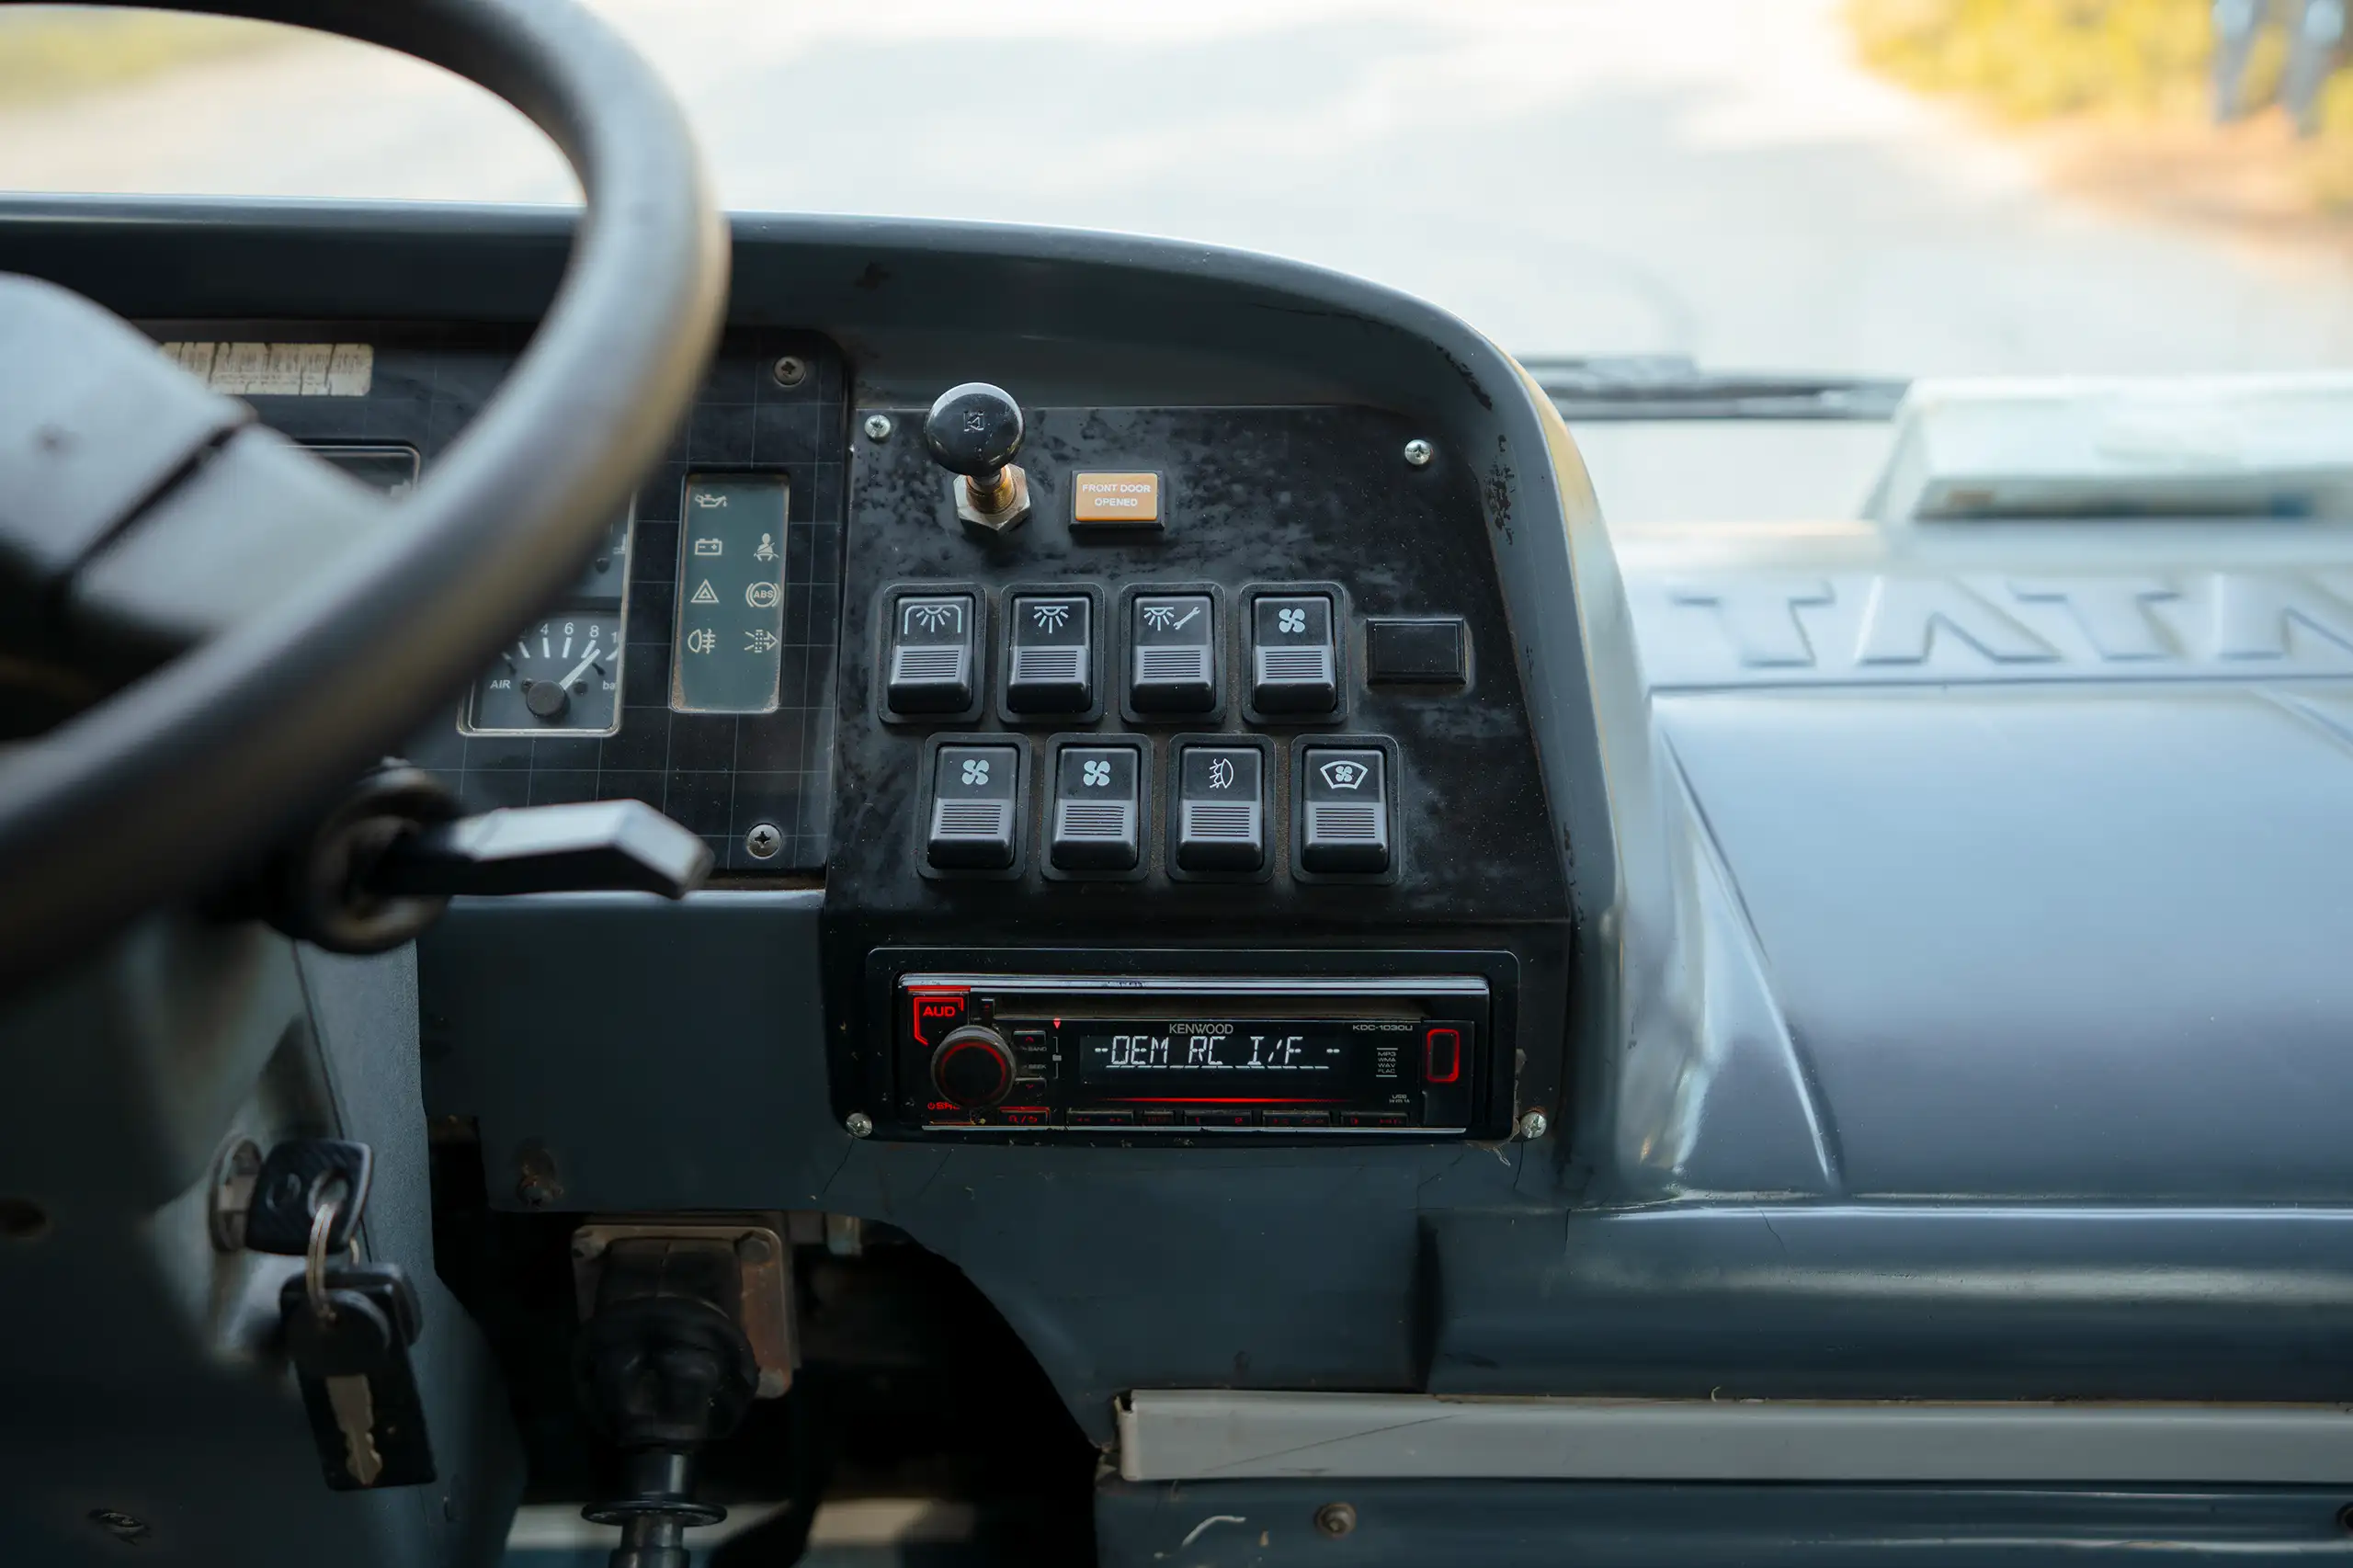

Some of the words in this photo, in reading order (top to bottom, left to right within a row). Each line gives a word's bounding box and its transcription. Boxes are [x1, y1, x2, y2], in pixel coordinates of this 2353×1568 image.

[1082, 483, 1118, 493] FRONT
[1120, 484, 1152, 493] DOOR
[1094, 497, 1138, 506] OPENED
[753, 589, 774, 598] ABS
[540, 623, 549, 635] 4
[564, 622, 574, 635] 6
[589, 625, 600, 638] 8
[610, 631, 619, 644] 1
[490, 679, 511, 689] AIR
[602, 680, 616, 690] ba
[922, 1005, 957, 1017] AUD
[1168, 1023, 1234, 1035] KENWOOD
[1188, 1035, 1227, 1065] RC
[1246, 1035, 1304, 1066] I/F
